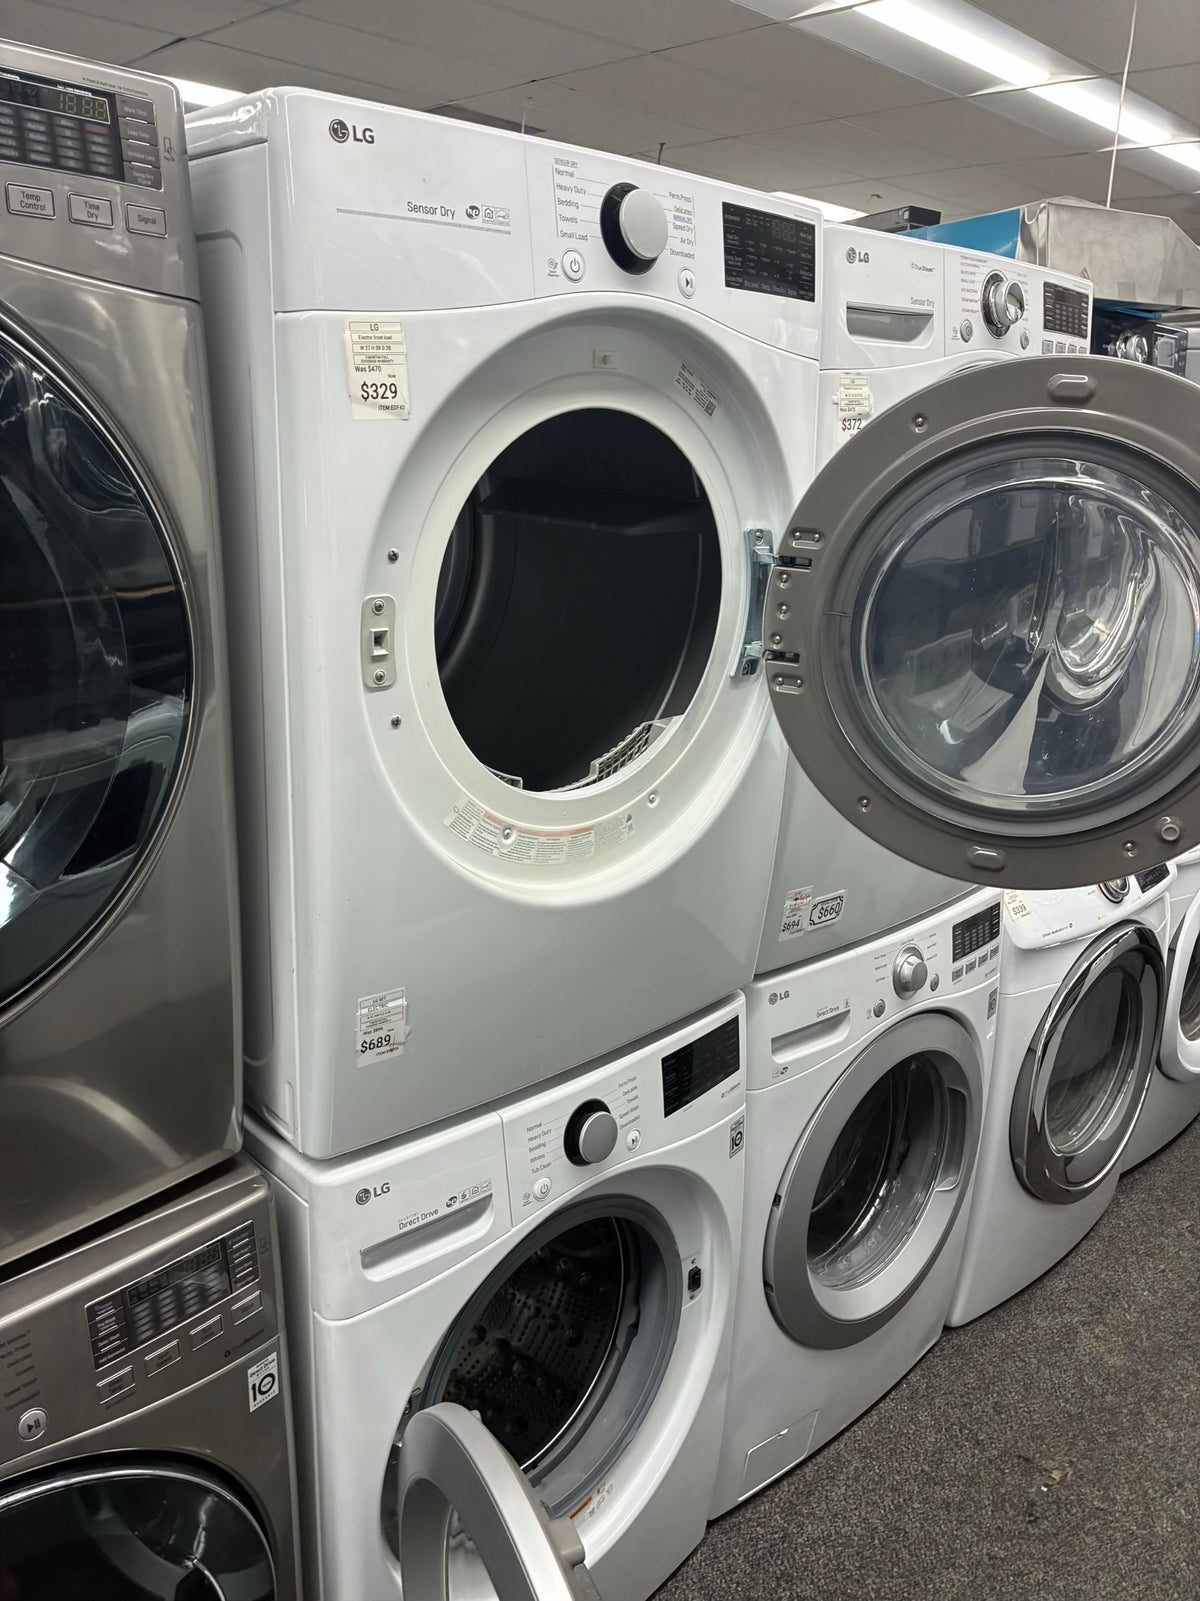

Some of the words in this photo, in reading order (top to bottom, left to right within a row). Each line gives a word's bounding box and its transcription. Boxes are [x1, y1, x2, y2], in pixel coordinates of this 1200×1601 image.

[352, 125, 375, 144] LG
[555, 168, 574, 178] Normal
[556, 183, 573, 194] Heavy
[574, 186, 586, 195] Duty
[20, 200, 46, 212] Control
[84, 201, 100, 211] Time
[558, 198, 579, 209] Bedding
[87, 210, 99, 221] Dry
[407, 201, 438, 216] Sensor
[440, 206, 456, 220] Dry
[674, 205, 692, 216] Delicates
[138, 214, 157, 226] Signal
[558, 214, 578, 223] Towels
[672, 222, 686, 231] Speed
[560, 230, 574, 239] Small
[576, 232, 588, 241] Load
[670, 248, 695, 259] Downloaded
[858, 252, 870, 264] LG
[910, 297, 926, 306] Sensor
[926, 300, 935, 308] Dry
[361, 381, 397, 402] $329
[842, 417, 862, 431] $372
[818, 902, 840, 920] $660
[1012, 904, 1026, 916] $339
[782, 919, 800, 932] $694
[779, 990, 790, 1000] LG
[817, 1010, 829, 1018] Direct
[829, 1006, 839, 1014] Drive
[361, 1034, 391, 1054] $689
[527, 1122, 542, 1133] Normal
[528, 1133, 541, 1143] Heavy
[542, 1128, 552, 1138] Duty
[732, 1131, 742, 1150] 10
[529, 1142, 546, 1153] Bedding
[530, 1153, 545, 1163] Whites
[531, 1166, 540, 1174] Tub
[540, 1162, 552, 1172] Clean
[374, 1182, 390, 1198] LG
[399, 1217, 420, 1230] Direct
[421, 1208, 438, 1221] Drive
[250, 1366, 263, 1378] Direct
[264, 1358, 275, 1368] Drive
[252, 1373, 275, 1403] 10
